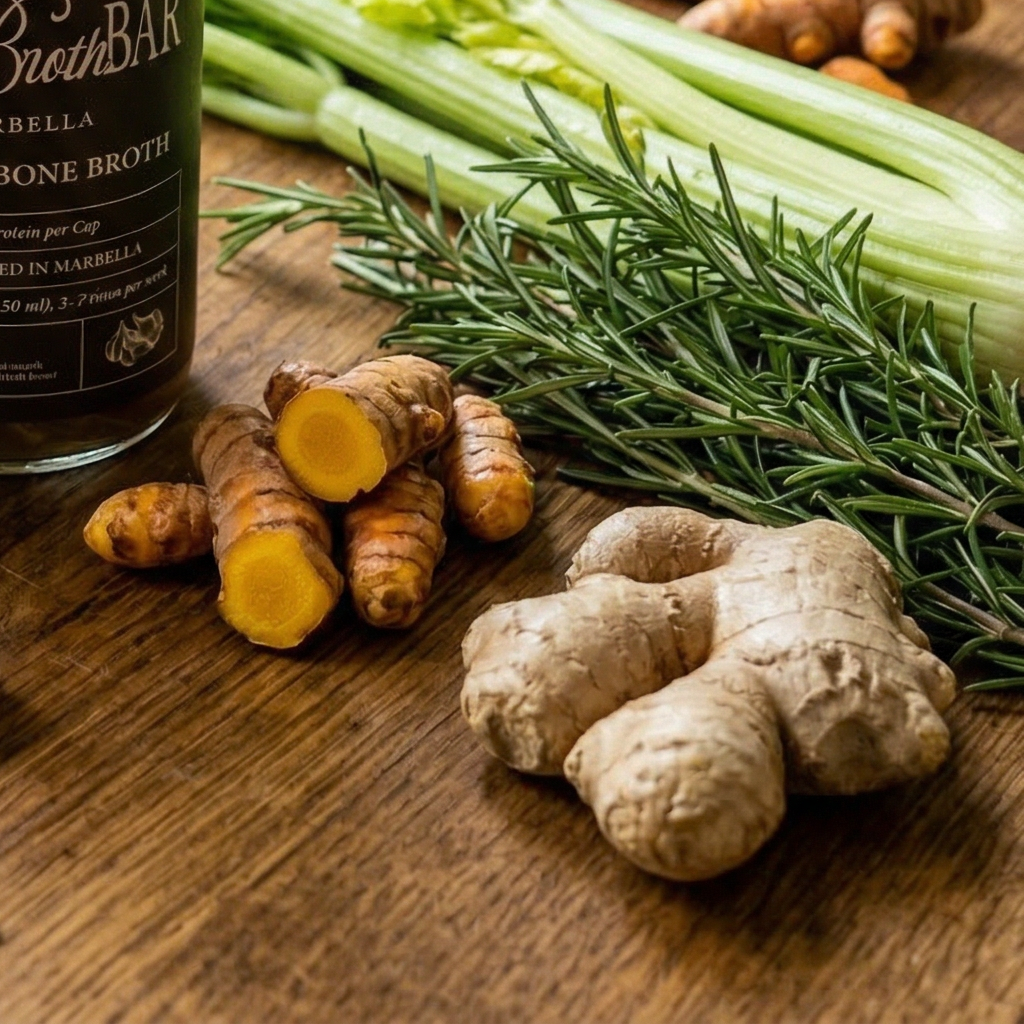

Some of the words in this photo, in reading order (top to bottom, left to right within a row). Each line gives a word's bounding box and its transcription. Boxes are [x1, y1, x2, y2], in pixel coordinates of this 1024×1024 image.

[86, 131, 171, 180] BROTH
[43, 225, 69, 242] per
[72, 220, 101, 236] Cap
[29, 261, 50, 276] IN
[53, 241, 143, 274] MARBELLA
